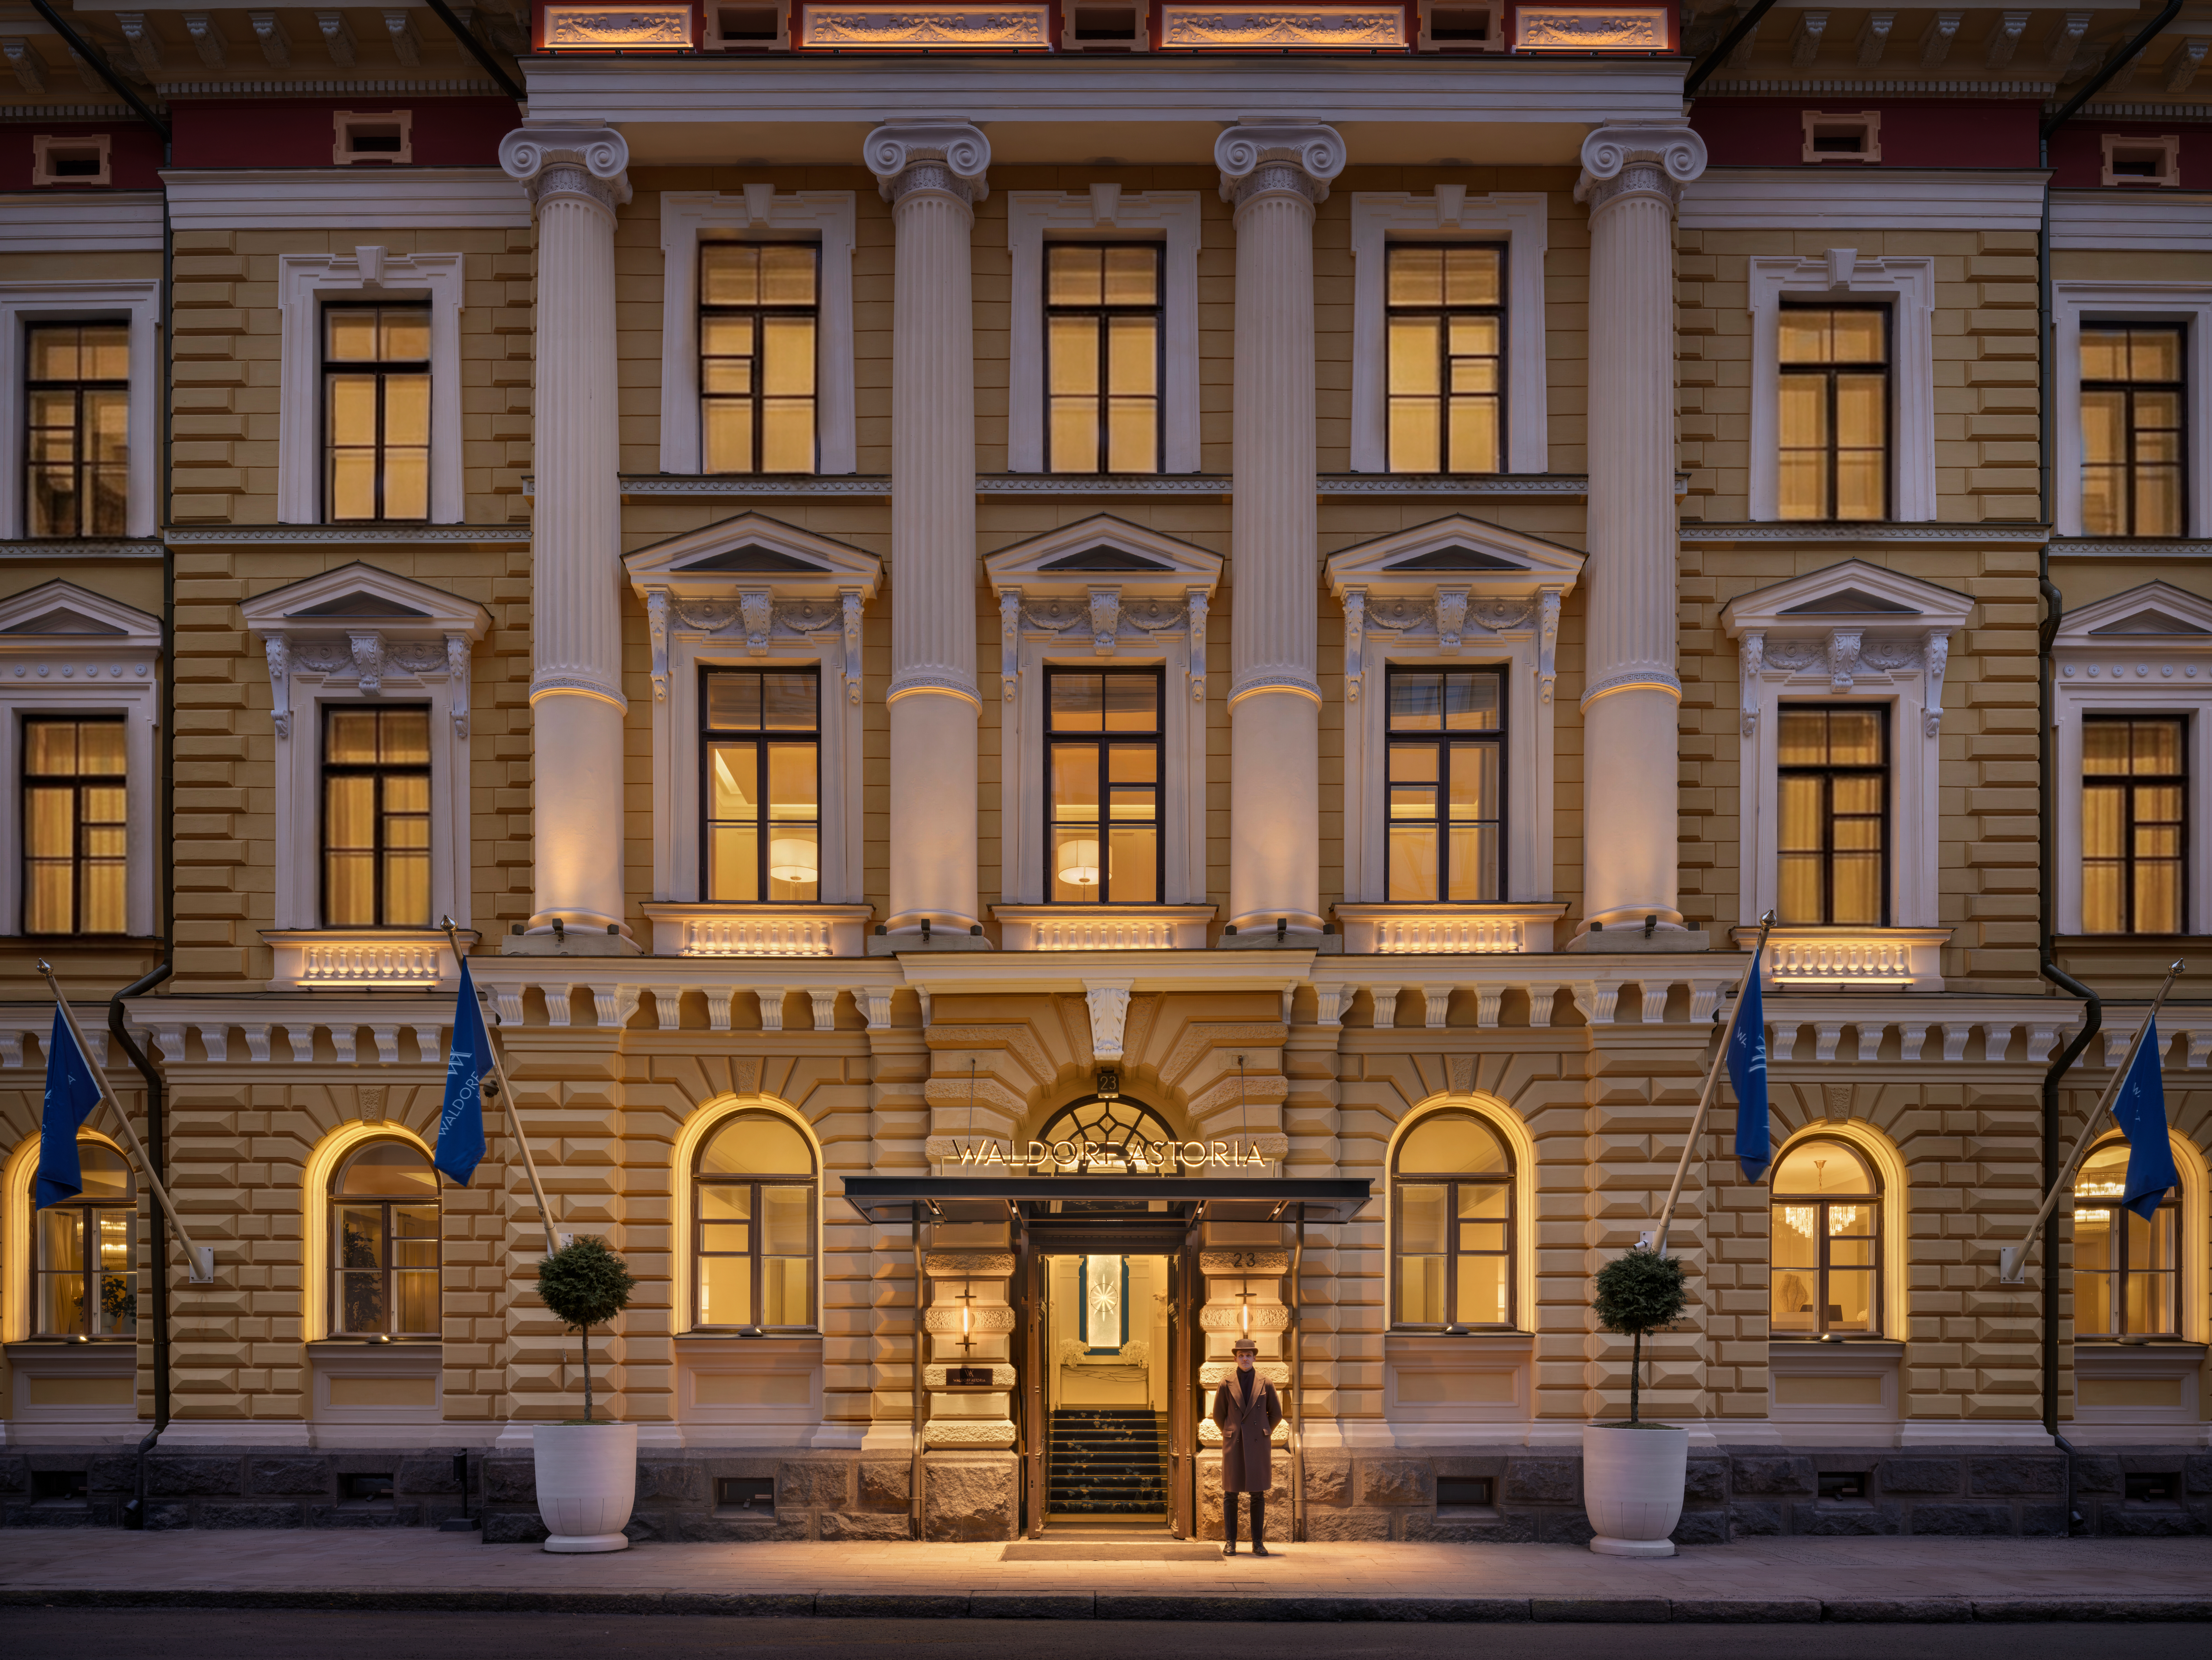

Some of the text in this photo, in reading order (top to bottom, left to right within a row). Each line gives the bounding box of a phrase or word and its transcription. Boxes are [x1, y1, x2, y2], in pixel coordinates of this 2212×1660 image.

[1100, 1076, 1116, 1090] 23
[439, 1071, 480, 1135] WALDORF
[952, 1139, 1266, 1167] WALDORF ASTORIA
[1233, 1252, 1255, 1267] 23
